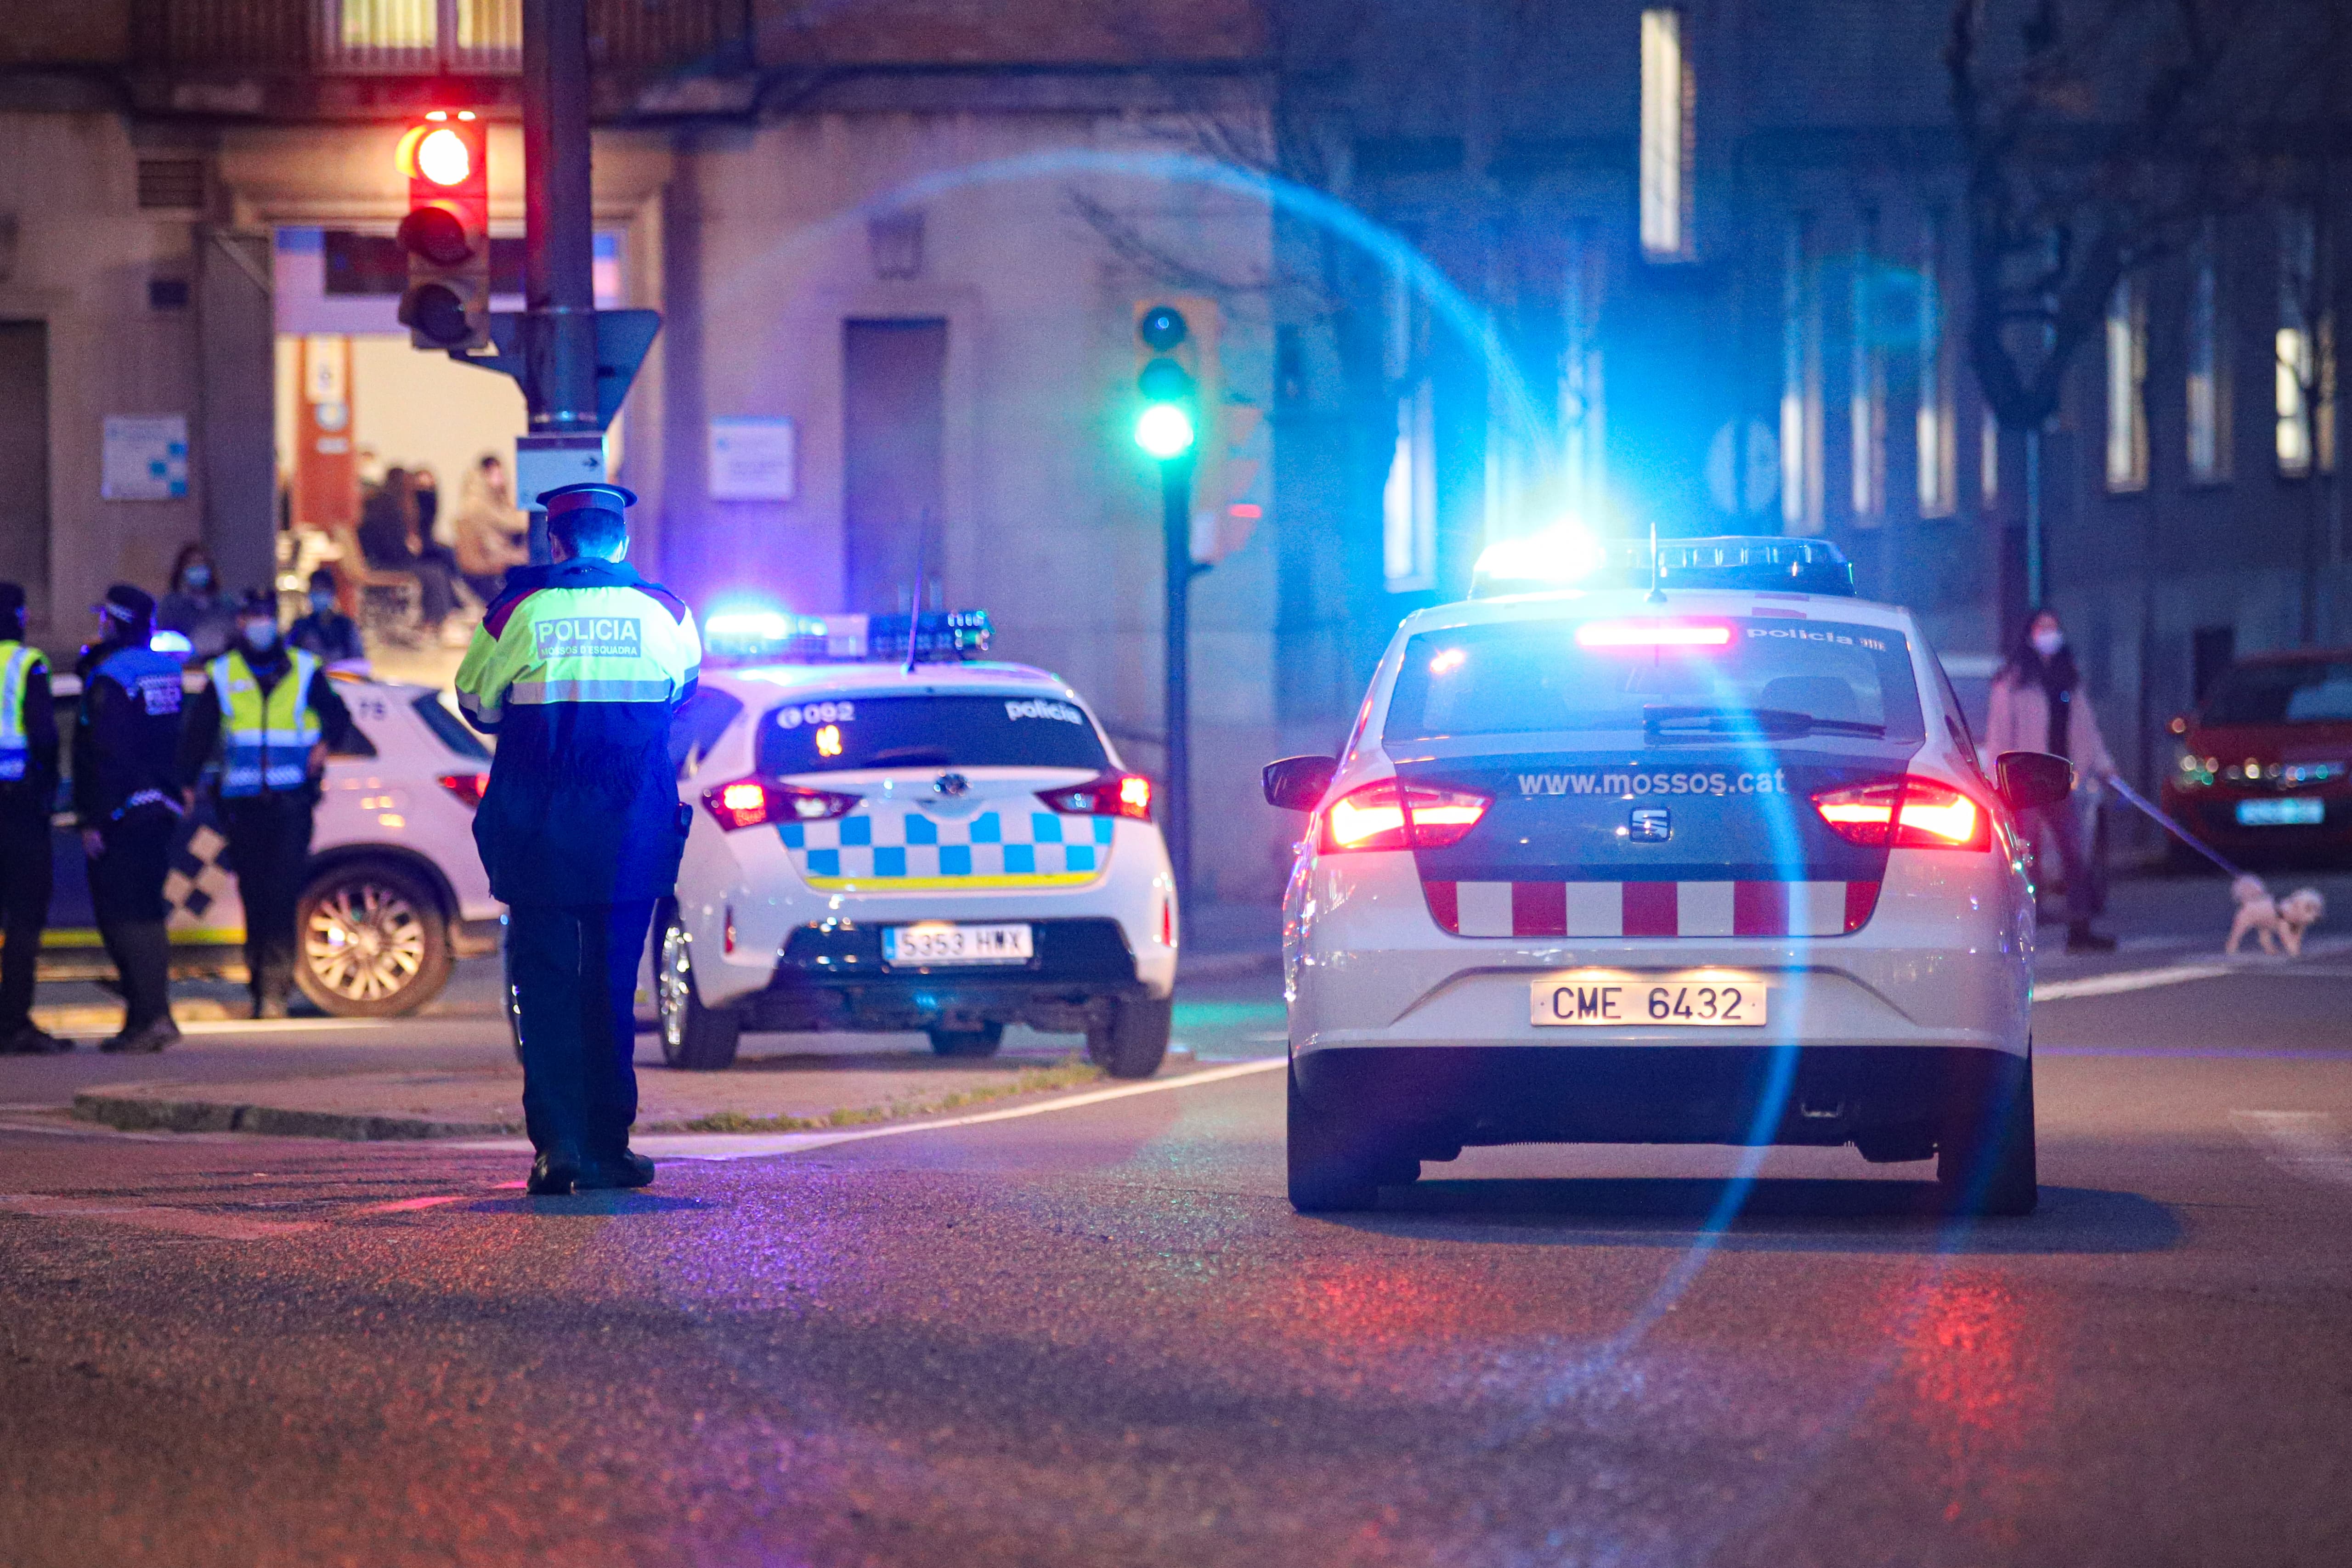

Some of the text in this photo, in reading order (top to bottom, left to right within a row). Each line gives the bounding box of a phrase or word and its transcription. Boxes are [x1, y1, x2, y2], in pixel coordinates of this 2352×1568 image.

[539, 619, 637, 643] POLICIA
[1747, 629, 1853, 645] policia
[542, 646, 577, 656] MOSSOS
[1518, 768, 1786, 794] www.mossos.cat
[903, 932, 964, 956] 5353
[1553, 987, 1742, 1019] CME 6432
